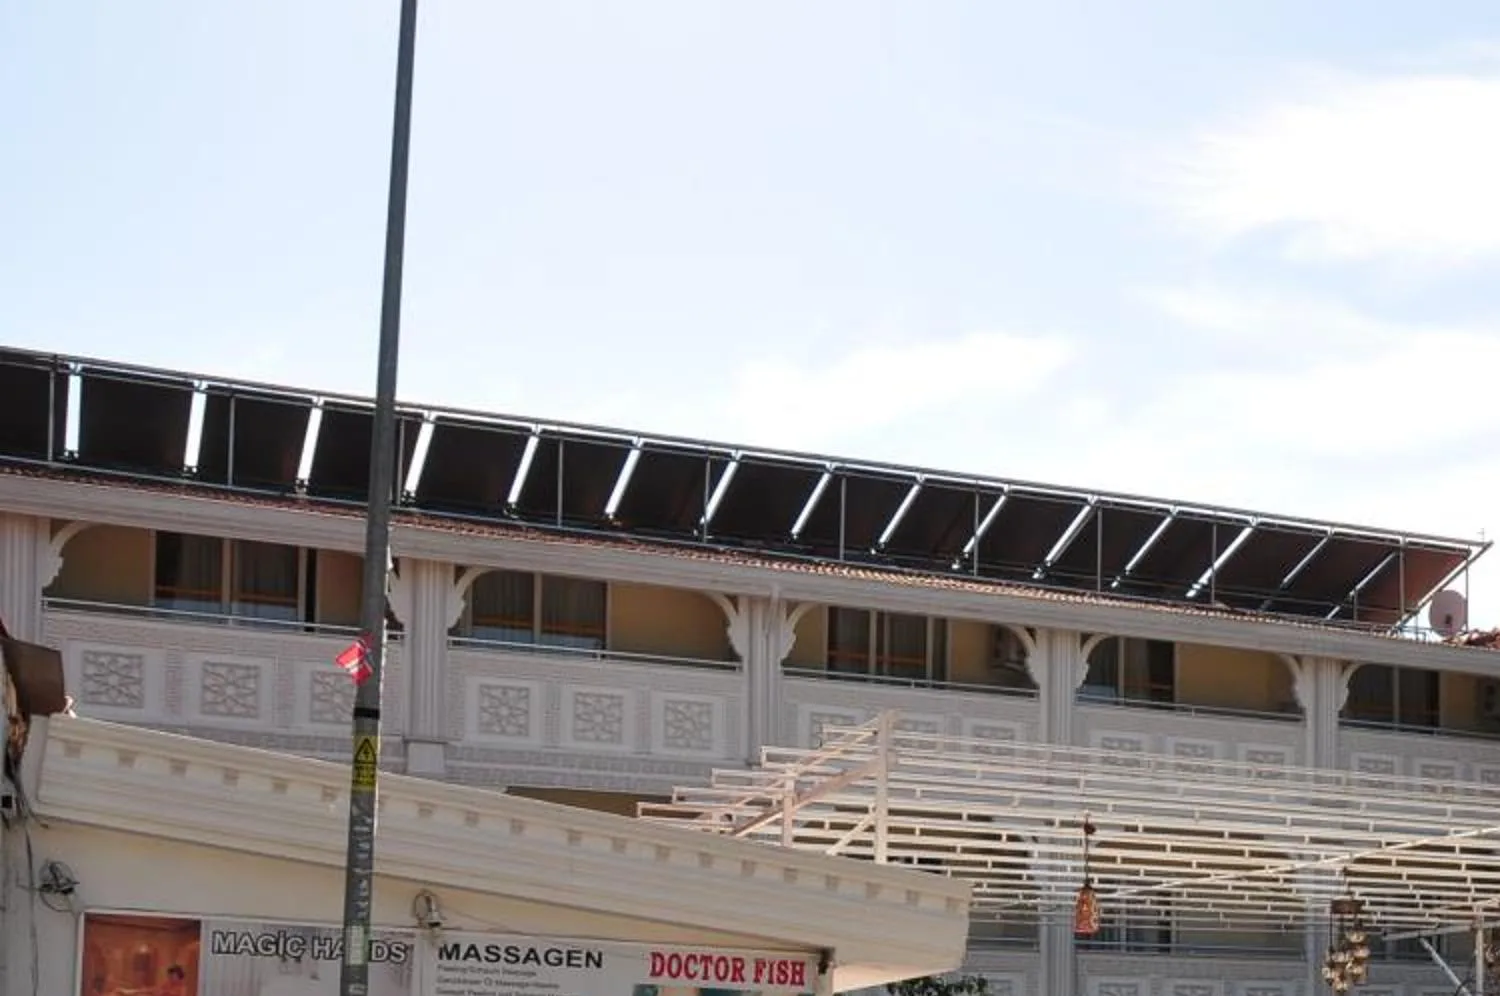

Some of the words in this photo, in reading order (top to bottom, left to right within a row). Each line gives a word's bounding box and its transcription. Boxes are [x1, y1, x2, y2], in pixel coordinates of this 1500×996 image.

[311, 936, 407, 963] HADS
[437, 943, 604, 969] MASSAGEN
[649, 951, 746, 985] DOCTOR
[752, 959, 807, 987] FISH
